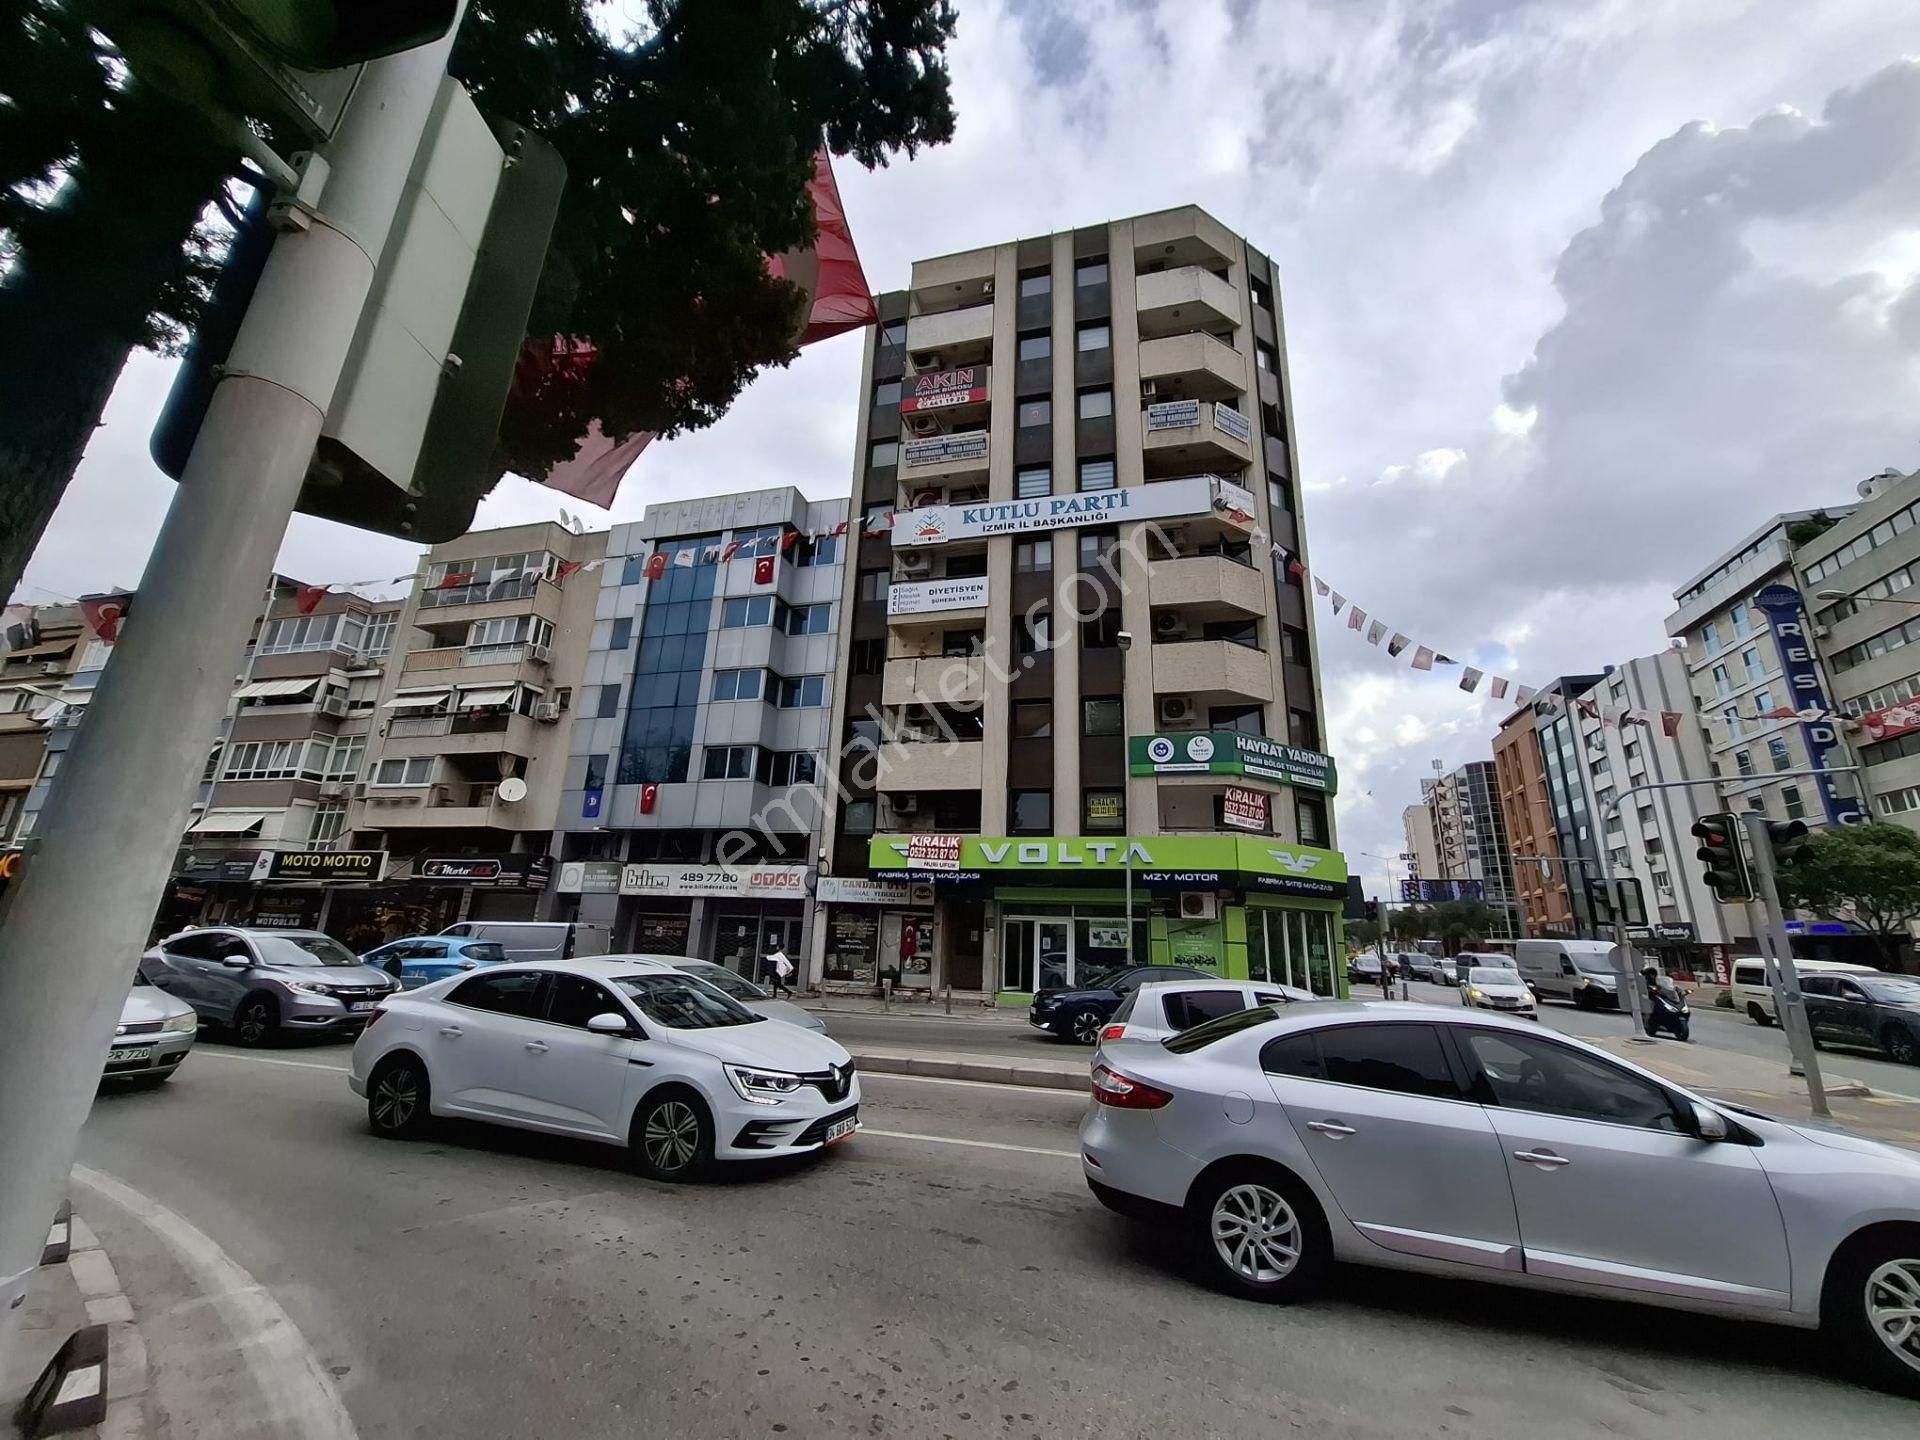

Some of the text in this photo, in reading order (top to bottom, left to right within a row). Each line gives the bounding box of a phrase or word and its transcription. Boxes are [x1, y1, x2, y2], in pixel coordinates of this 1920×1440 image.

[915, 368, 974, 391] AKIN
[962, 490, 1129, 525] KUTLU PARTİ
[982, 512, 1108, 533] İZMİR İL BAŞKANLIĞI
[928, 584, 984, 596] DİYETİSYEN
[1236, 736, 1329, 769] HAYRAT YARDIM
[1243, 753, 1263, 765] İZMİR
[1263, 759, 1285, 770] BÖLGE
[1225, 787, 1265, 808] KİRALIK
[910, 835, 960, 848] KİRALIK
[909, 846, 959, 860] 0532 322 87 00
[979, 842, 1153, 864] VOLTA
[282, 855, 372, 868] MOTO MOTTO
[679, 872, 704, 882] 489
[750, 872, 801, 887] UTAX
[936, 872, 980, 880] MAĞAZASI
[1143, 873, 1219, 882] MZY MOTOR
[842, 880, 883, 890] CANDAN
[914, 889, 932, 897] Audi
[126, 1049, 149, 1059] 720
